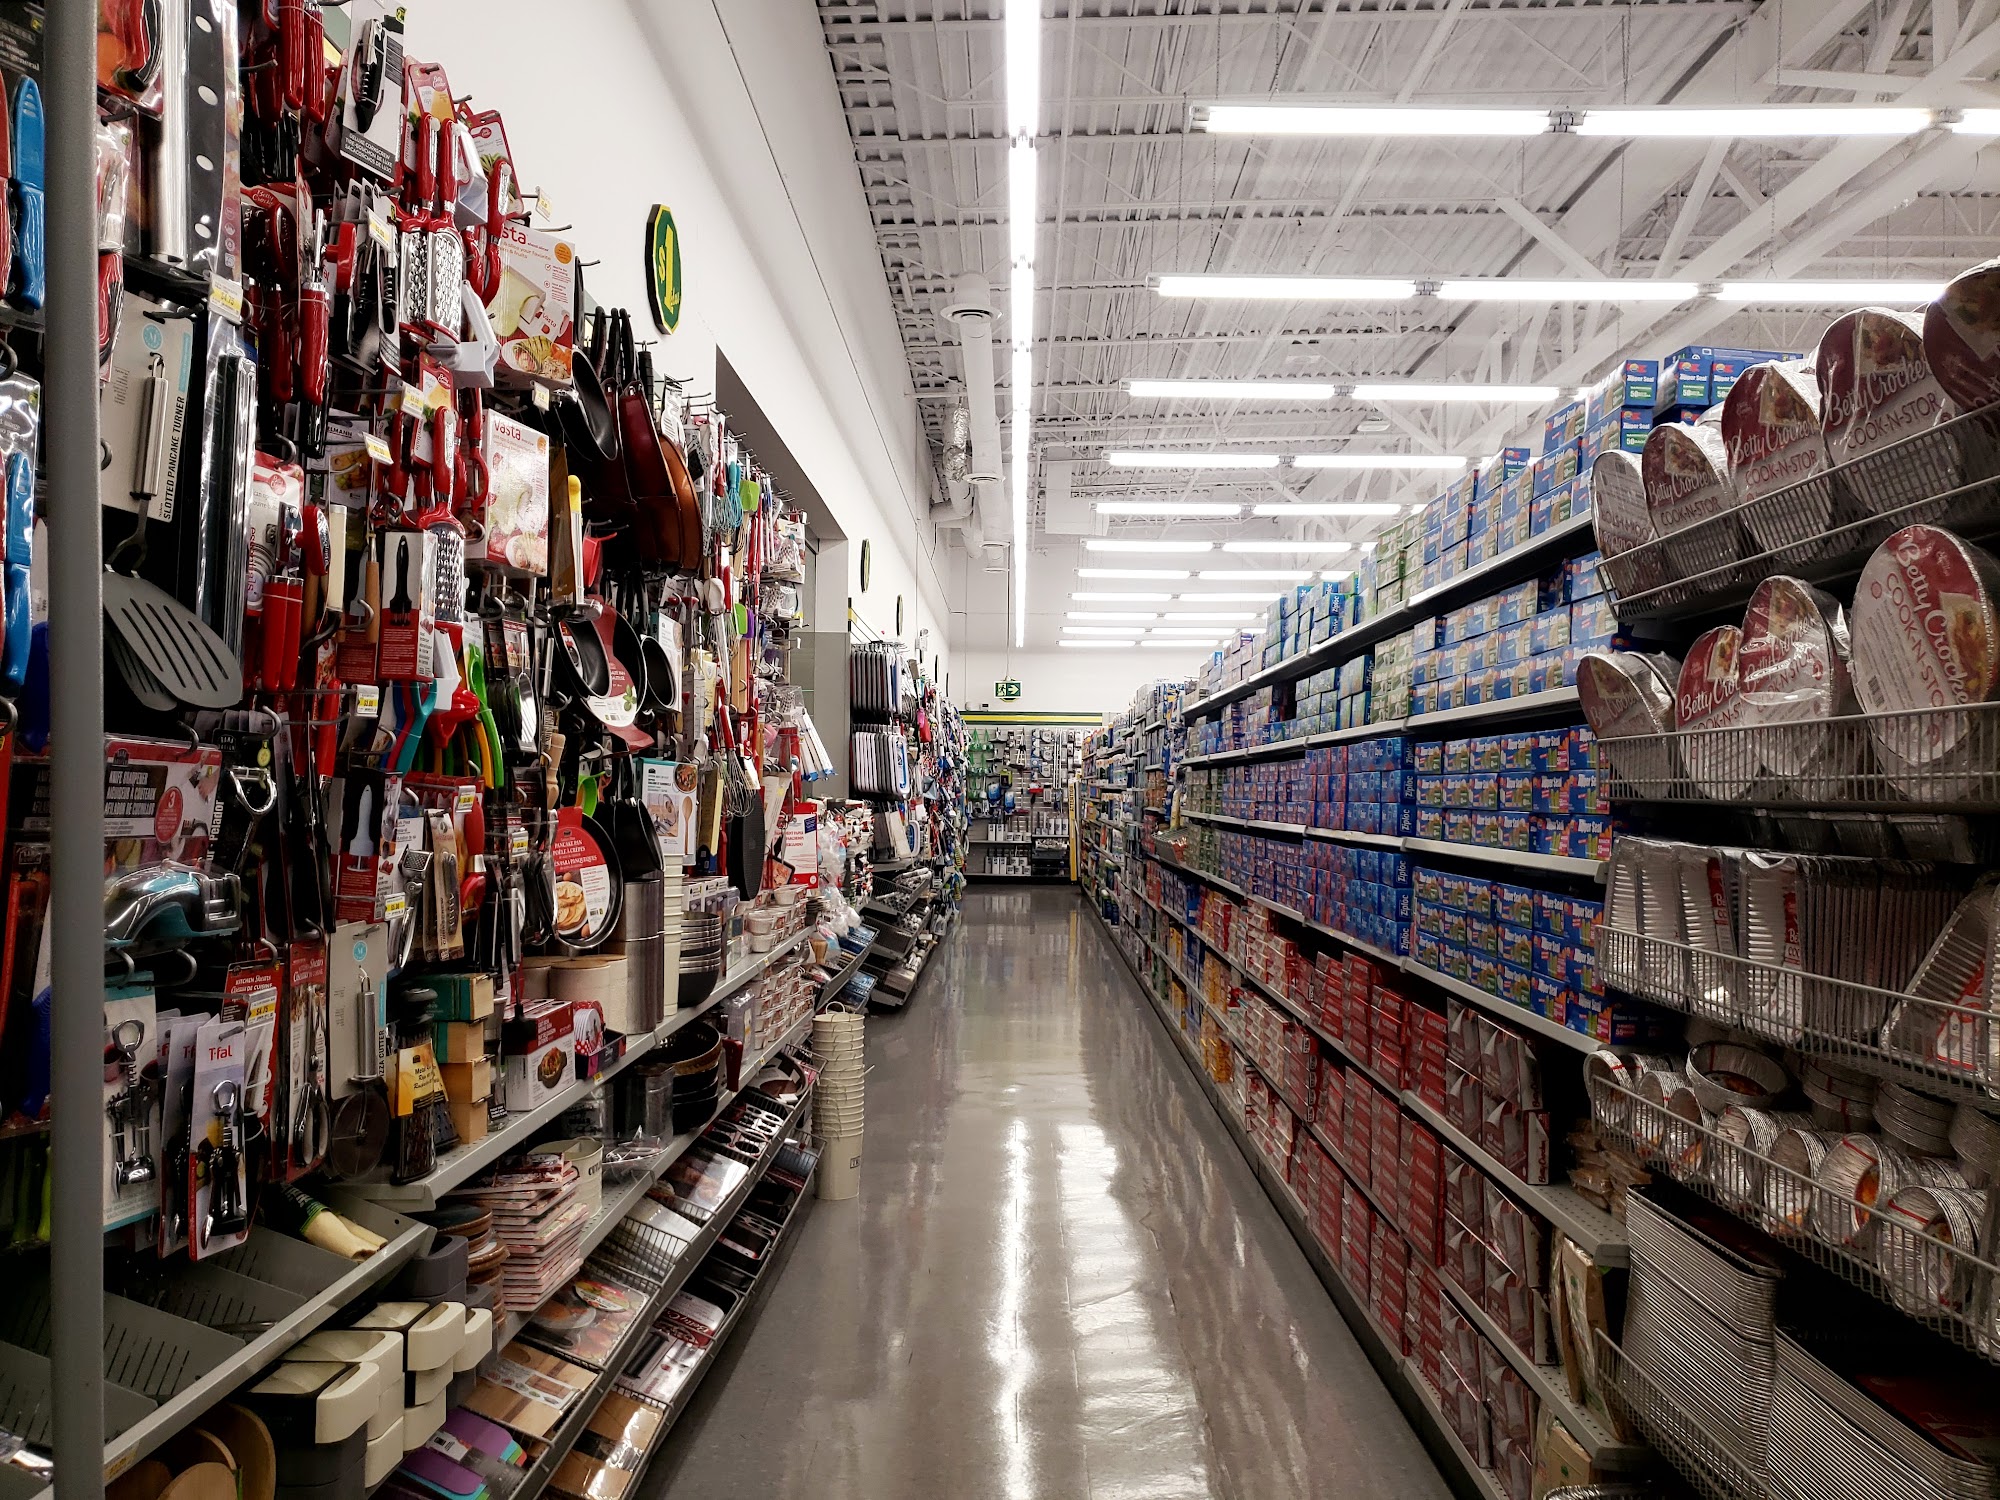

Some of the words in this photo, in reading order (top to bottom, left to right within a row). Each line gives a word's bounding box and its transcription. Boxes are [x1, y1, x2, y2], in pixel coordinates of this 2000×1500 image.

[501, 226, 527, 245] sta
[1828, 389, 1869, 426] Betty
[1867, 354, 1933, 405] Crocker
[173, 396, 185, 433] TURNER
[1847, 392, 1942, 450] COOK-N-STOR
[493, 419, 521, 441] vasta
[1728, 434, 1766, 465] Betty
[1765, 414, 1816, 452] Crocker
[169, 436, 180, 480] PANCAKE
[1745, 449, 1816, 486] COOK-N-STOR
[164, 480, 174, 520] SLOTTED
[1648, 481, 1674, 506] Betty
[1670, 467, 1717, 498] Crocker
[1660, 496, 1722, 527] COOK-N-STOR
[1897, 537, 1932, 614] Betty
[1923, 608, 1970, 705] Crocke
[1887, 571, 1945, 708] COOK-N-STO
[1680, 691, 1713, 721] Betty
[1405, 741, 1414, 764] Ziploc
[168, 791, 176, 808] 3
[1405, 775, 1414, 802] Ziploc
[209, 800, 224, 841] Pelador
[1403, 808, 1413, 832] Ziploc
[1578, 819, 1591, 834] Zipper
[1591, 821, 1603, 834] Seal
[554, 841, 574, 849] PANCAKE
[1398, 860, 1407, 884] Ziploc
[1400, 894, 1409, 918] Ziploc
[1584, 905, 1595, 919] Seal
[1400, 927, 1409, 951] Ziploc
[235, 976, 255, 985] KITCHEN
